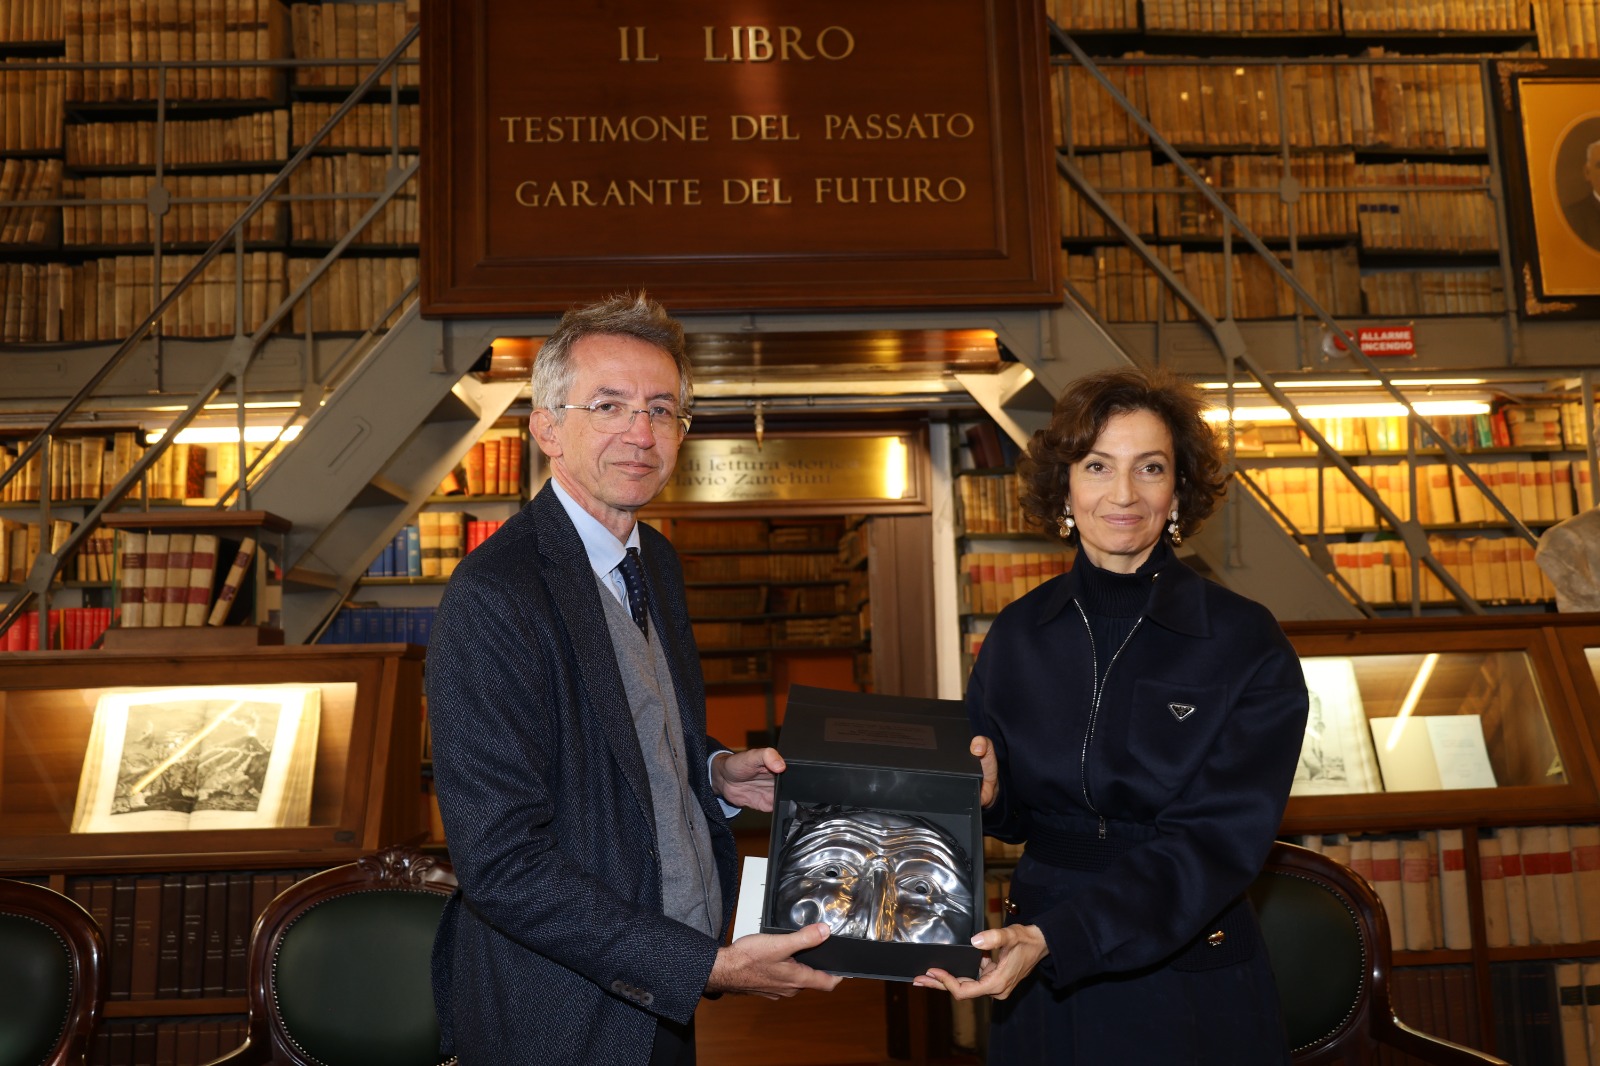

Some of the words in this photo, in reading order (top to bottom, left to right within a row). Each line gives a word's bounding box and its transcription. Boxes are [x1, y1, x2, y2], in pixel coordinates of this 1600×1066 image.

[618, 26, 660, 63] IL
[704, 25, 856, 63] LIBRO
[499, 115, 709, 143] TESTIMONE
[730, 114, 800, 141] DEL
[824, 113, 975, 140] PASSATO
[515, 179, 702, 207] GARANTE
[722, 178, 792, 205] DEL
[815, 176, 967, 204] FUTURO
[1361, 331, 1411, 341] ALLARME
[1361, 341, 1413, 351] INCENDIO
[680, 459, 701, 472] di
[709, 459, 780, 472] lettura
[669, 473, 728, 487] lavio
